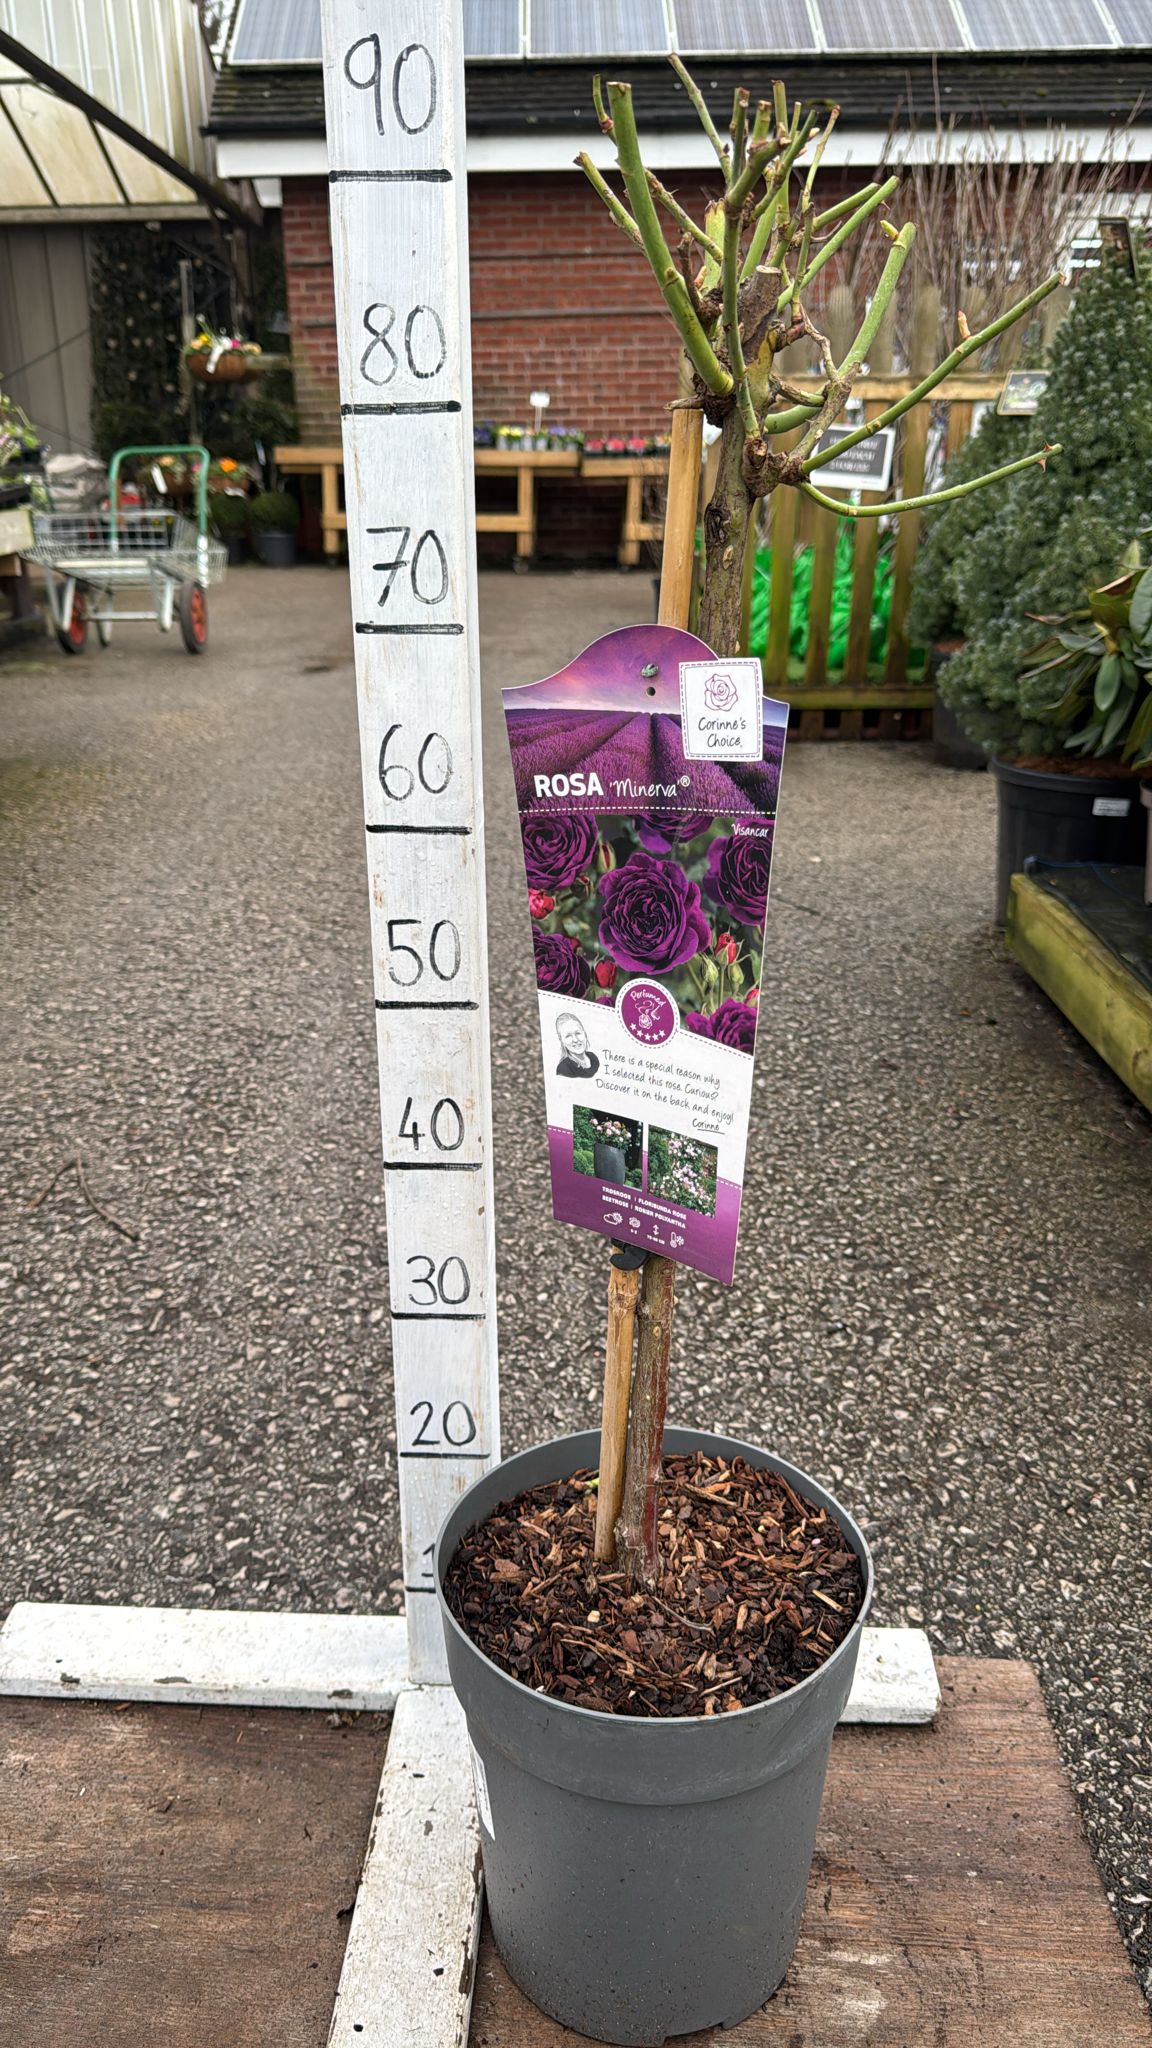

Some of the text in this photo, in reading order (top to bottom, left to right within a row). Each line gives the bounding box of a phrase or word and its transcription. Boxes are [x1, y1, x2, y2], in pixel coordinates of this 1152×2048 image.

[343, 33, 437, 135] 90
[359, 303, 447, 386] 80
[366, 526, 449, 606] 70
[697, 717, 747, 731] Corinne's
[378, 724, 453, 799] 60
[533, 772, 604, 798] ROSA
[731, 823, 769, 837] Visancar
[387, 918, 462, 983] 50
[630, 989, 666, 1007] Perfumed
[602, 1049, 626, 1063] There
[645, 1060, 674, 1073] special
[676, 1067, 701, 1080] reason
[703, 1074, 721, 1090] why
[612, 1068, 645, 1082] selected
[648, 1074, 664, 1087] this
[684, 1083, 719, 1101] Curious?
[398, 1095, 465, 1151] 40
[595, 1078, 734, 1126] Discover it on the back and enjoy!
[692, 1118, 721, 1131] Corinne
[406, 1255, 471, 1306] 30
[410, 1400, 478, 1447] 20
